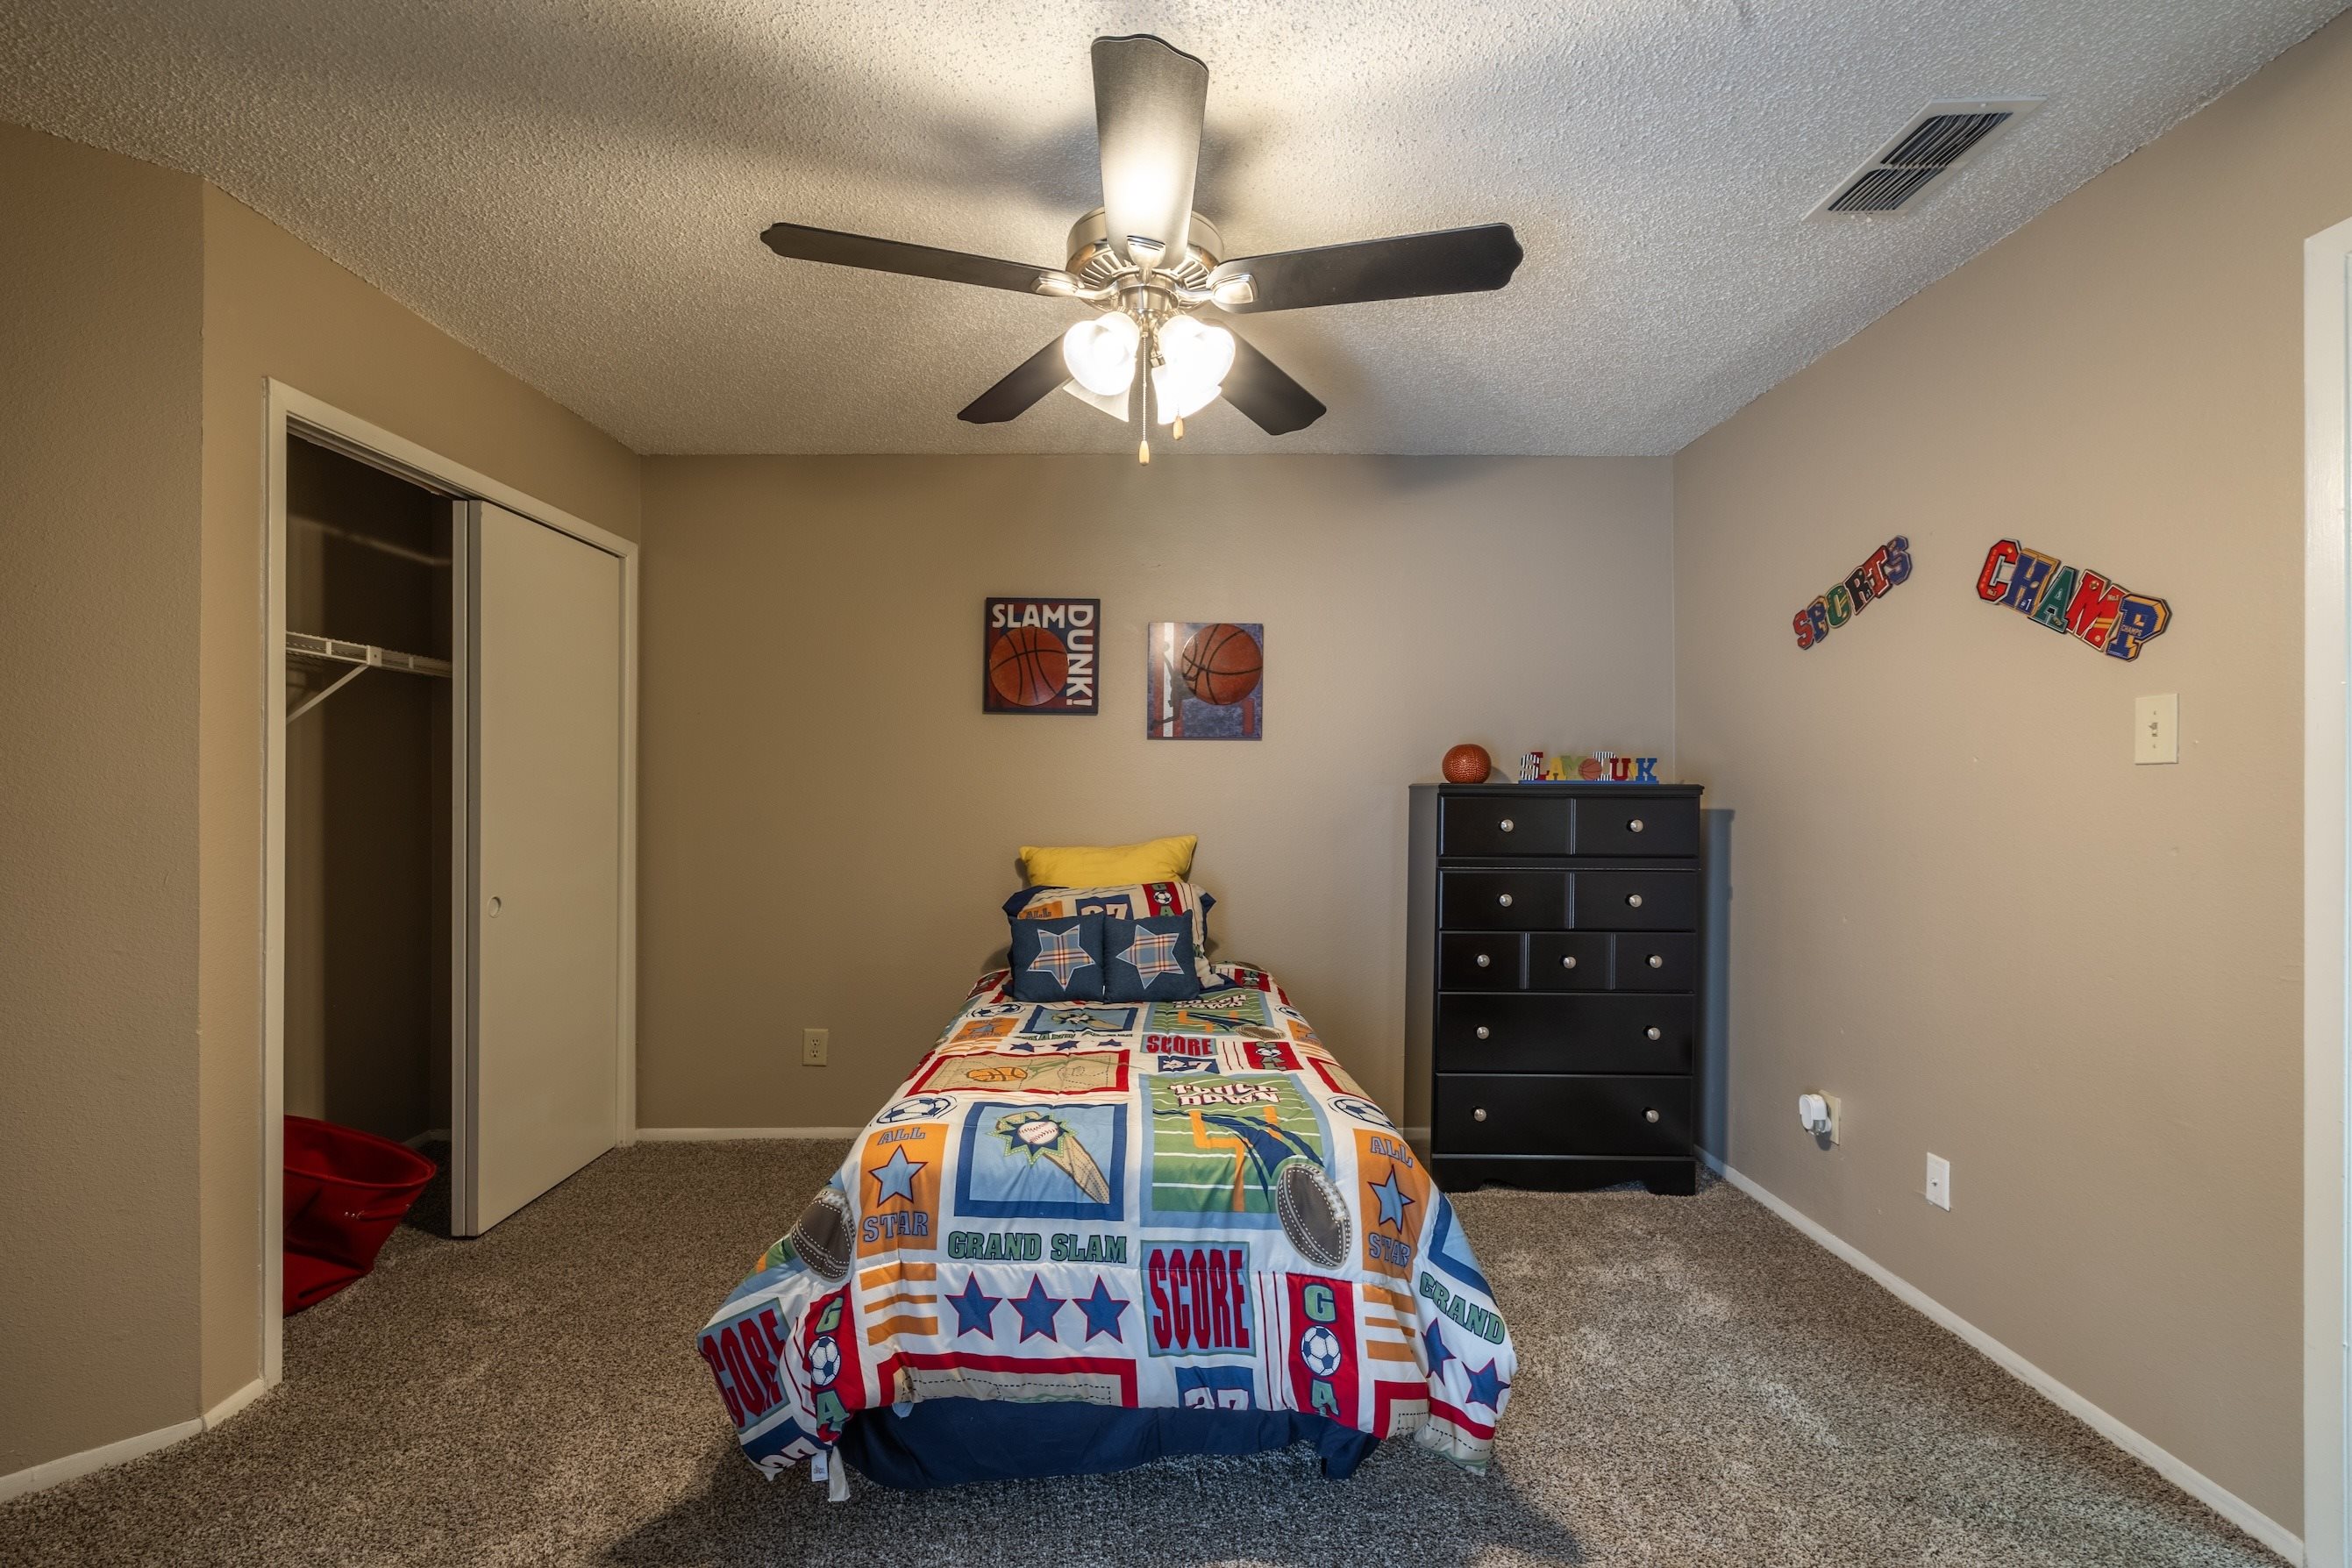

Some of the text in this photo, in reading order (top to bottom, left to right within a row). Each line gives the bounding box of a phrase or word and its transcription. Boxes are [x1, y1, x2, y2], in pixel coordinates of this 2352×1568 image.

[1793, 535, 1912, 650] SPORTS
[1976, 538, 2171, 662] CHAMP
[992, 603, 1066, 629] SLAM
[1066, 604, 1094, 707] DUNK!
[1145, 1035, 1214, 1057] SCORE
[1179, 1092, 1280, 1107] DOWN
[876, 1126, 926, 1145] ALL
[1370, 1136, 1414, 1169] ALL
[862, 1211, 929, 1244] STAR
[947, 1230, 1128, 1264] GRAND SLAM
[1368, 1231, 1412, 1269] STAR
[1148, 1248, 1250, 1350] SCORE
[1419, 1270, 1506, 1345] GRAND
